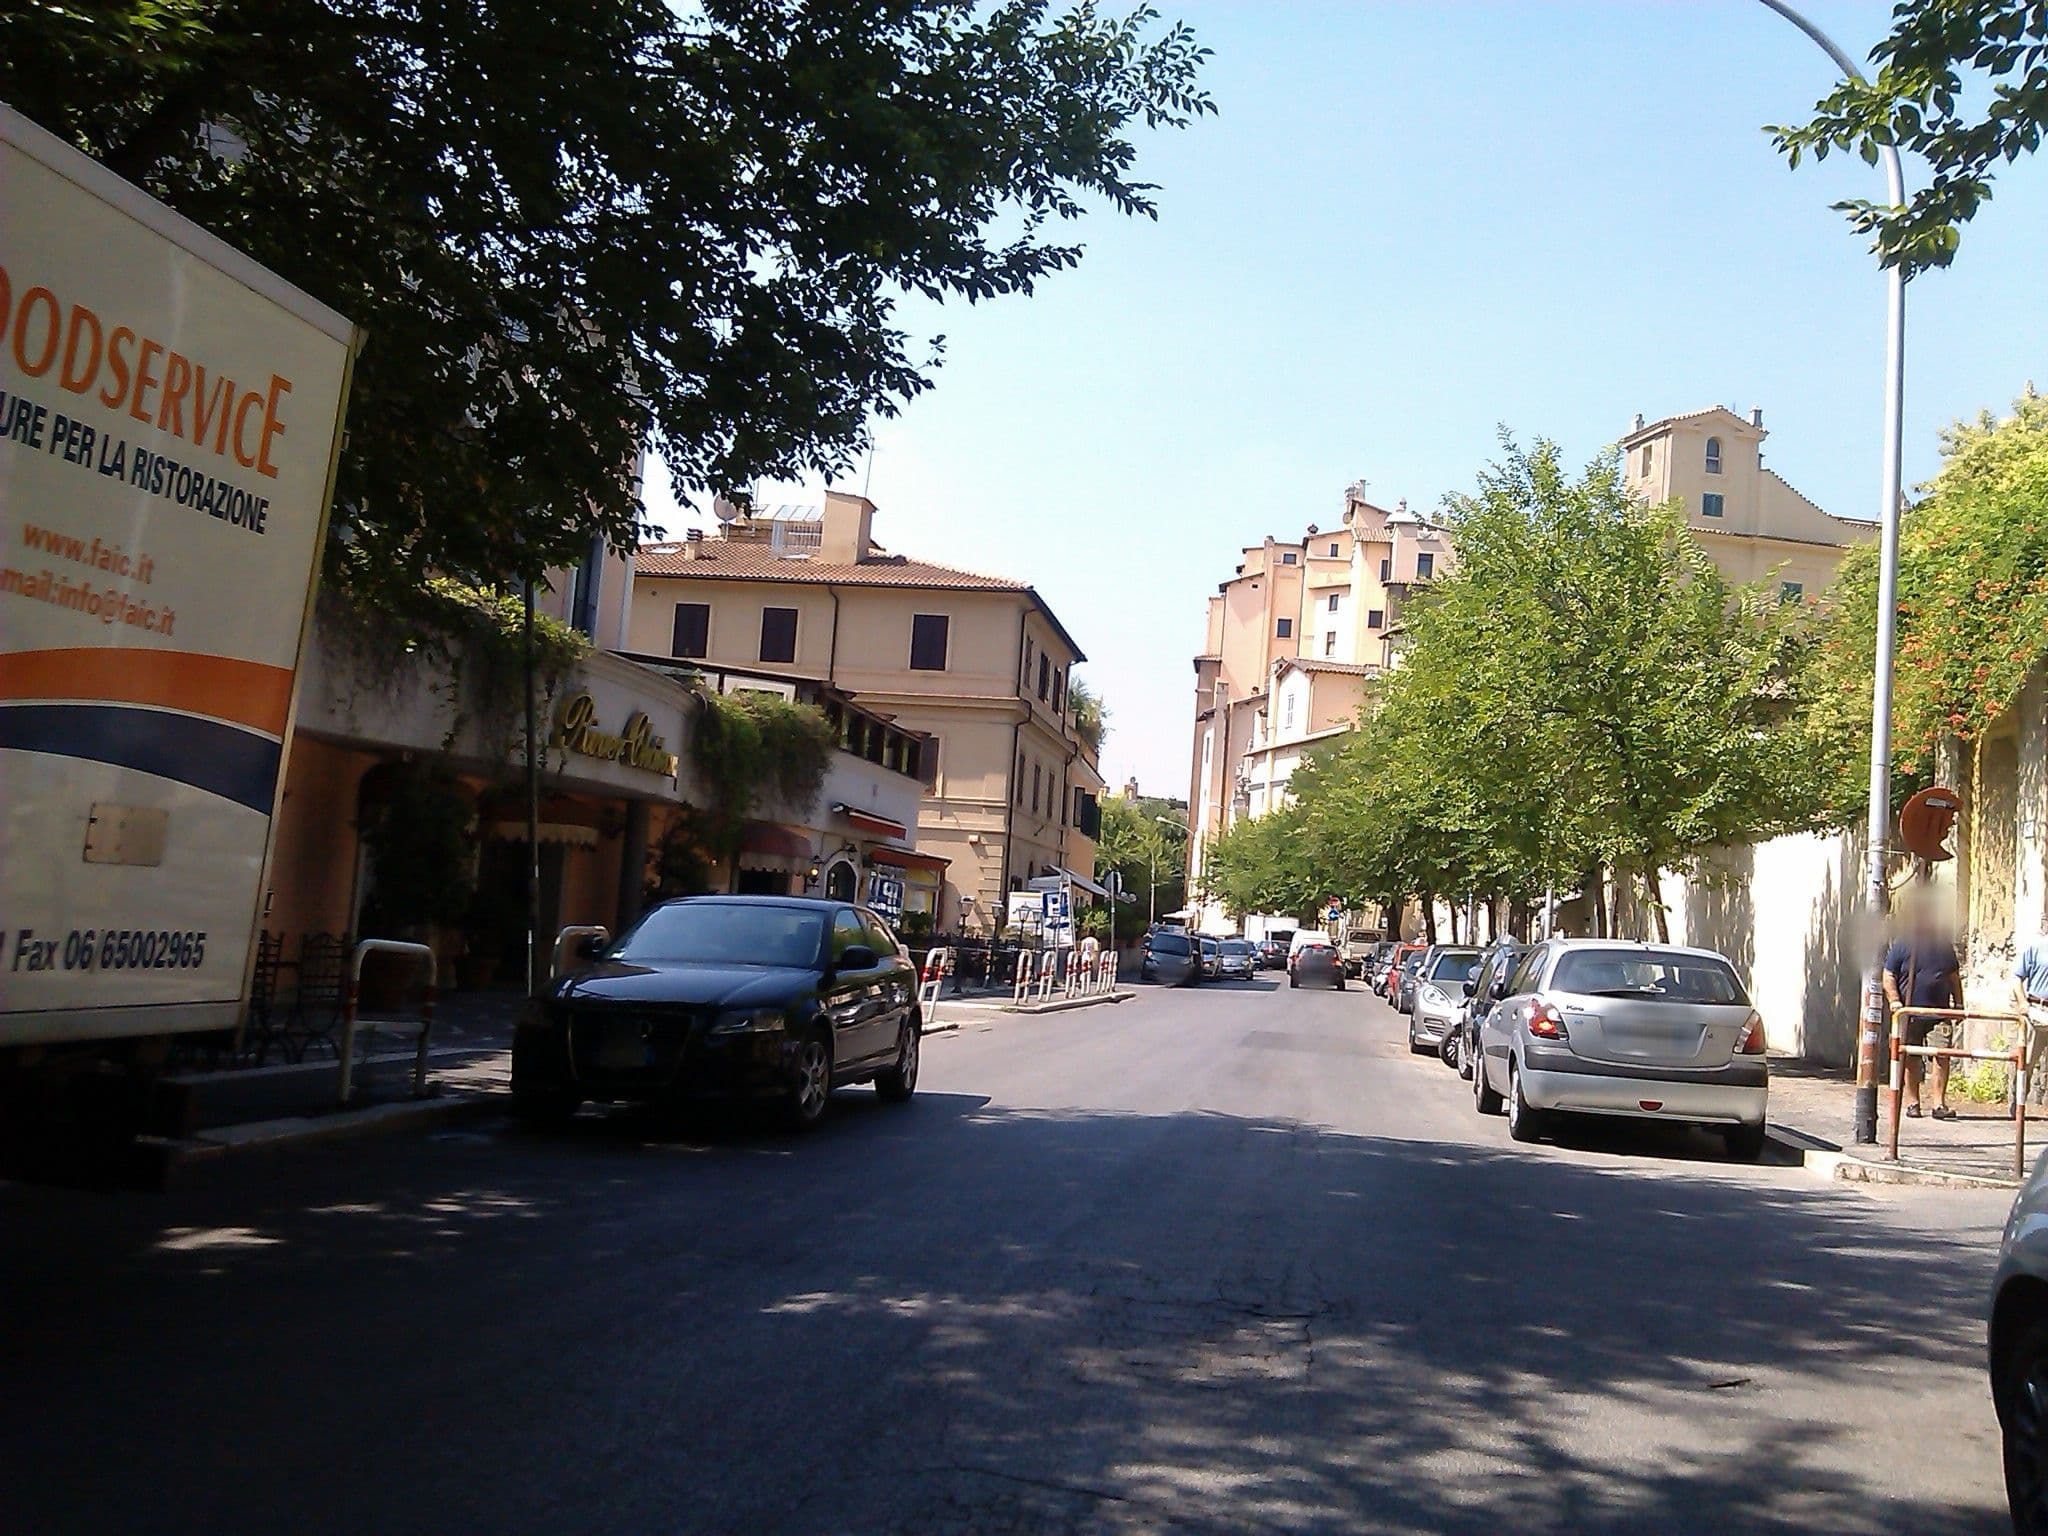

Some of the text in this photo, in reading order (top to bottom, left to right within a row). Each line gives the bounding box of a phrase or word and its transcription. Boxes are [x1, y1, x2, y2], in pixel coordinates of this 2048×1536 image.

[0, 266, 292, 479] ODSERVICE
[49, 413, 96, 468] PER
[98, 434, 125, 481] LA
[131, 447, 269, 535] RISTORAZIONE
[24, 523, 154, 584] www.faic.it
[10, 929, 59, 971] Fax
[63, 929, 96, 970] 06
[101, 930, 207, 969] 65002965
